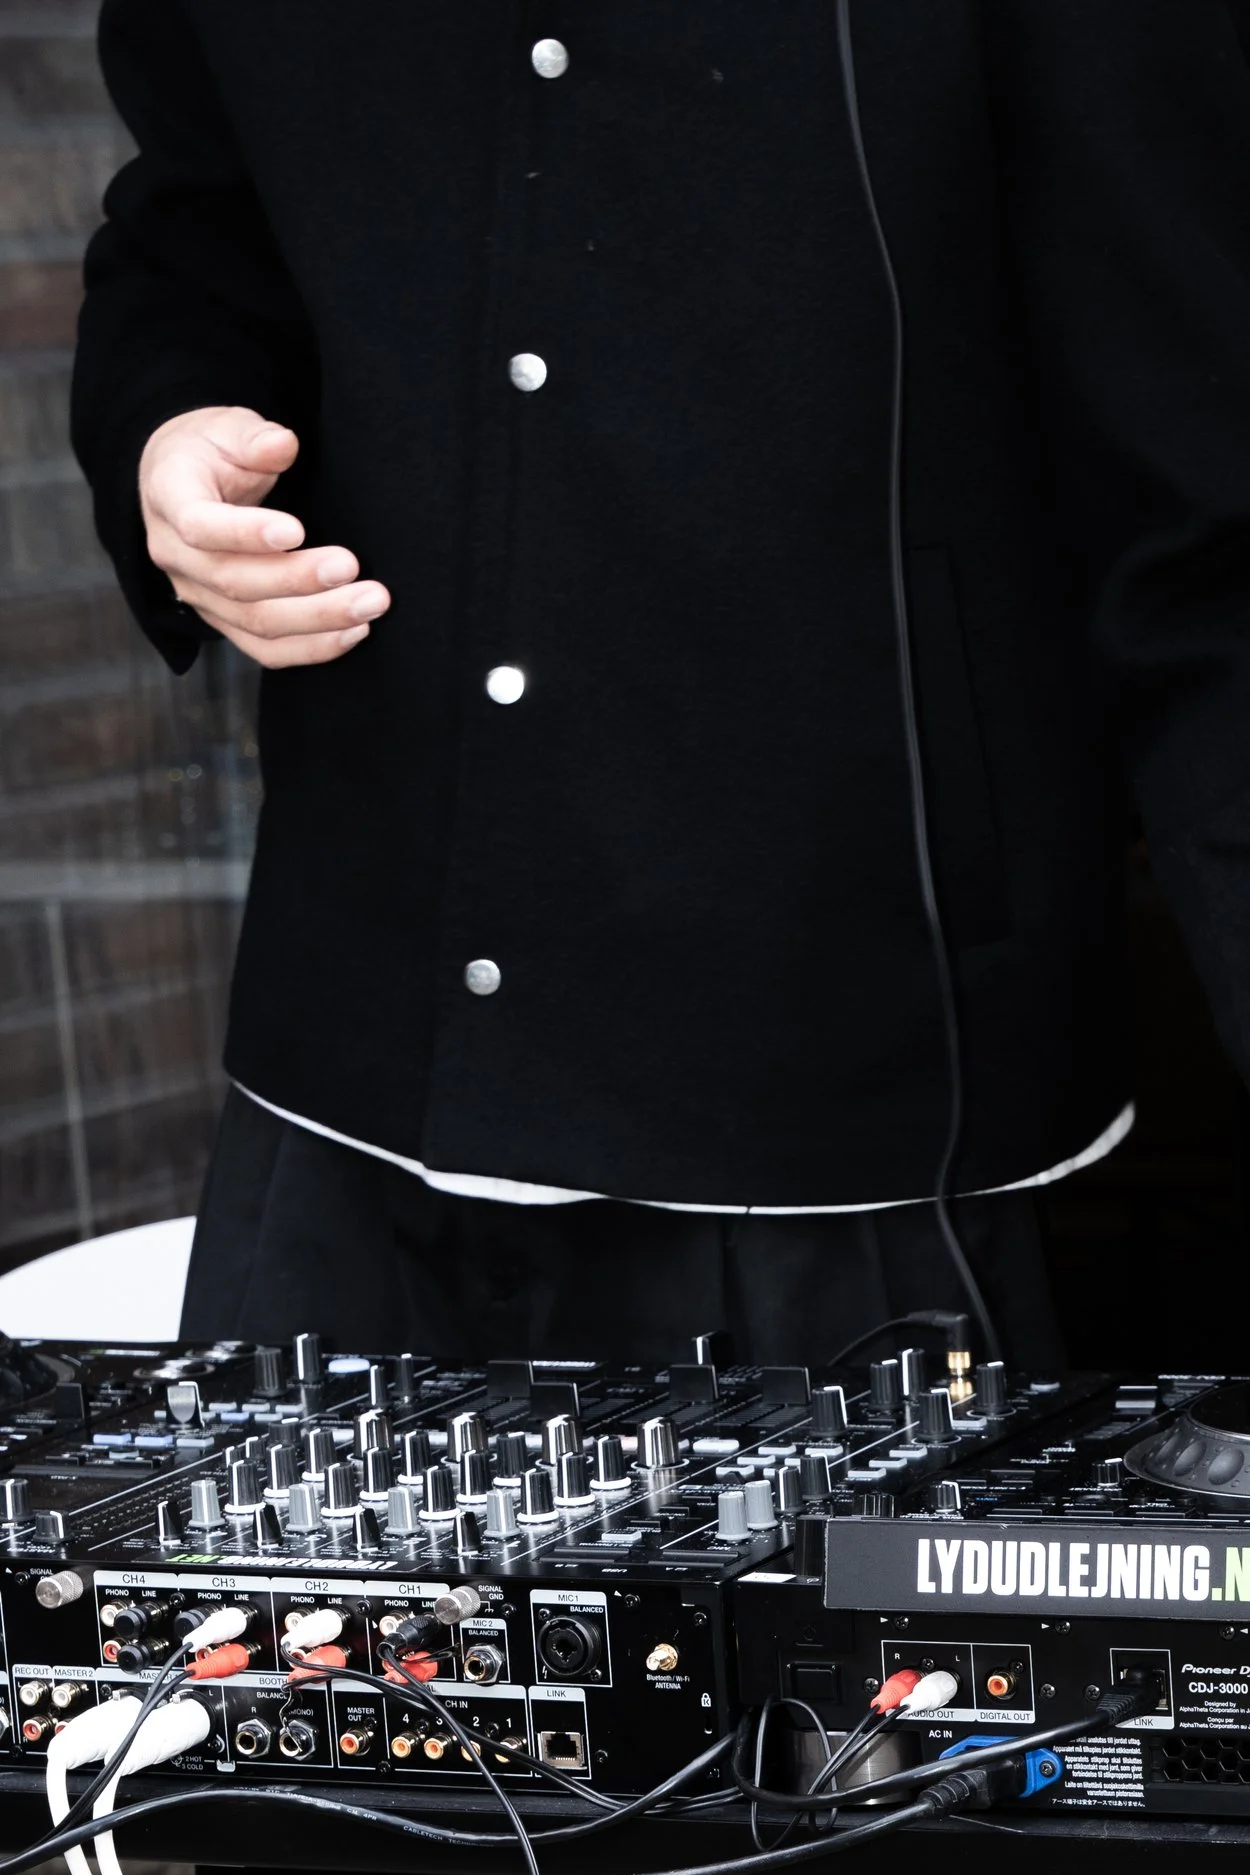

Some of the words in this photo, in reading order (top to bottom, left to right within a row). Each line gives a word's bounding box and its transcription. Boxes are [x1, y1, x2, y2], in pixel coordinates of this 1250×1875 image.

[165, 1554, 398, 1570] LYDUDLEJNING.NET
[105, 1588, 129, 1596] PHONO
[197, 1592, 222, 1600] PHONO
[291, 1596, 315, 1604] PHONO
[15, 1666, 31, 1675] REC
[32, 1667, 49, 1675] OUT
[55, 1668, 87, 1677] MASTER
[1181, 1664, 1236, 1675] Pioneer
[140, 1672, 172, 1681] MASR
[259, 1677, 287, 1685] BOOTH
[647, 1674, 672, 1682] Bluetooth
[1188, 1682, 1249, 1694] CDJ-3000
[445, 1700, 458, 1708] CH
[459, 1701, 468, 1709] IN
[402, 1713, 409, 1723] 4
[937, 1711, 954, 1719] OUT
[980, 1712, 1011, 1720] DIGITAL
[1014, 1713, 1031, 1721] OUT
[472, 1716, 480, 1727] 2
[506, 1718, 512, 1728] 1
[1134, 1718, 1154, 1726] LINK
[929, 1730, 941, 1738] AC
[943, 1730, 952, 1738] IN
